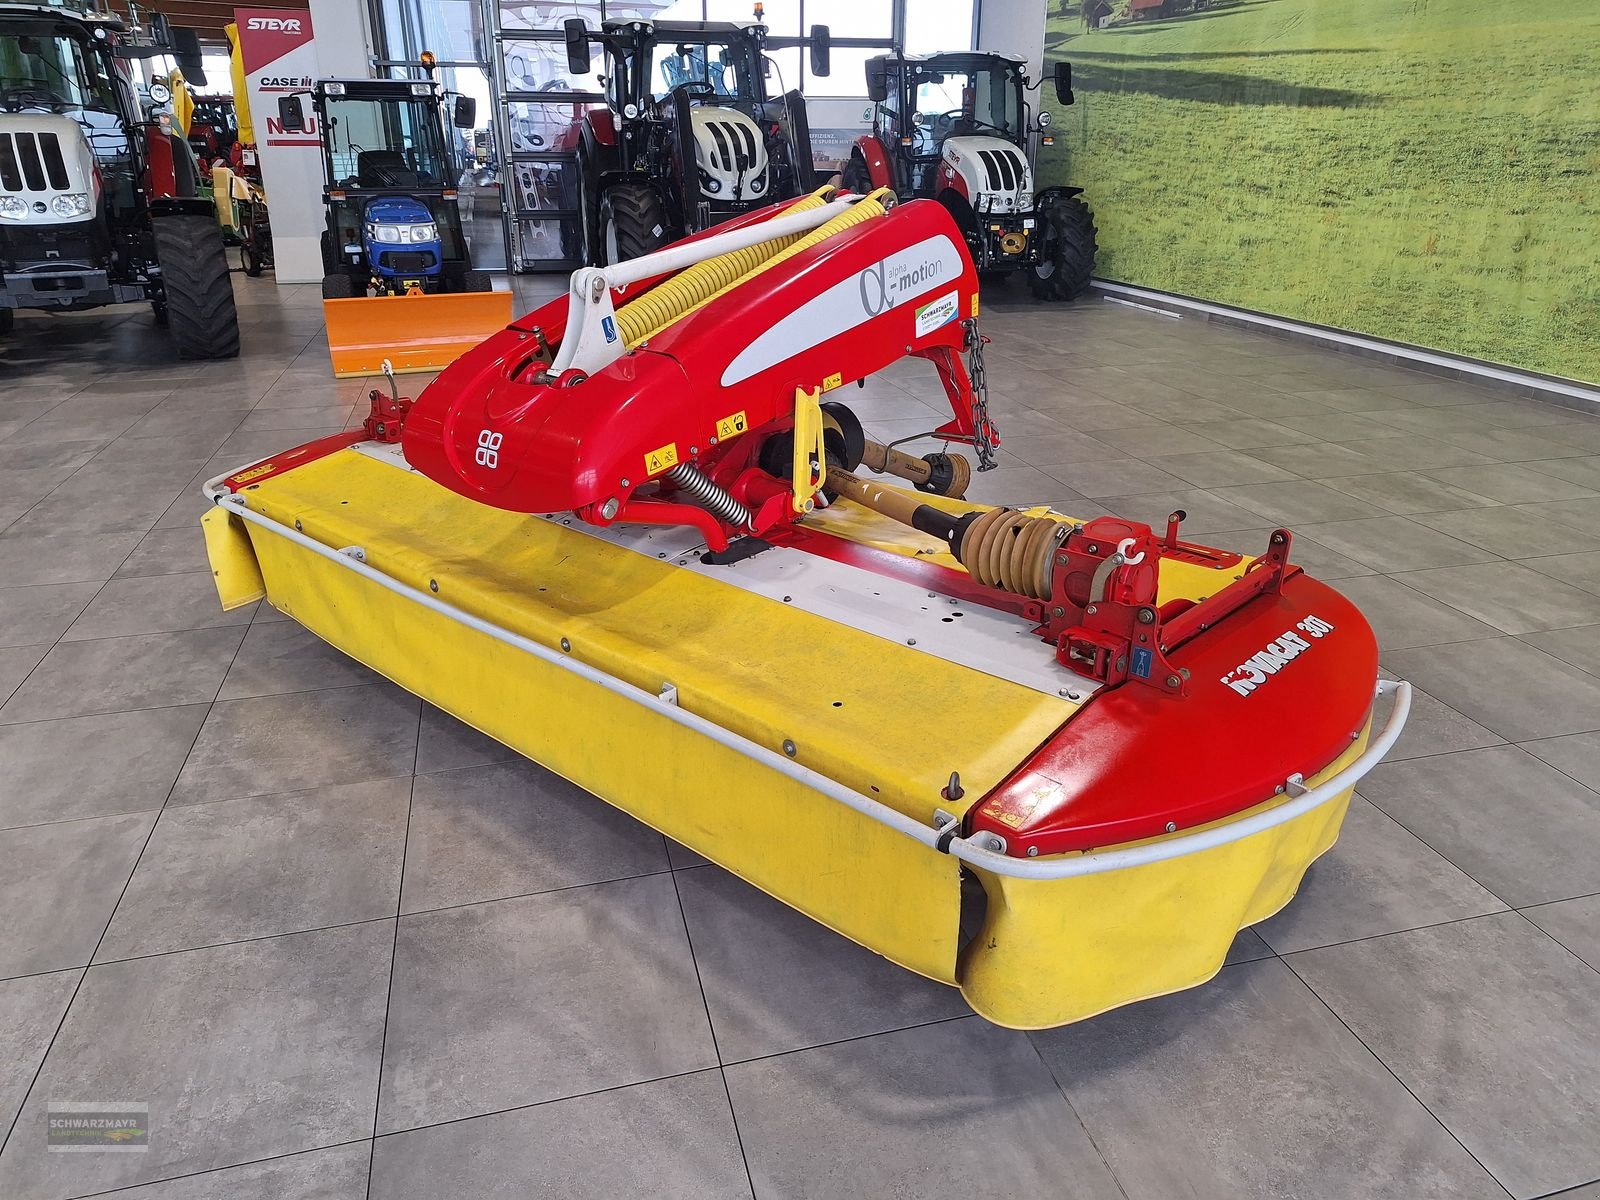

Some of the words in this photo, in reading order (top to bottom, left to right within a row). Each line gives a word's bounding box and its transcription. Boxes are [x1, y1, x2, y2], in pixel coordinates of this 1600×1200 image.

[247, 17, 301, 31] STEYR
[260, 77, 299, 87] CASE
[266, 117, 316, 134] NU
[888, 263, 907, 279] alpha
[1220, 630, 1312, 698] NOVACAT
[1296, 614, 1336, 639] 301
